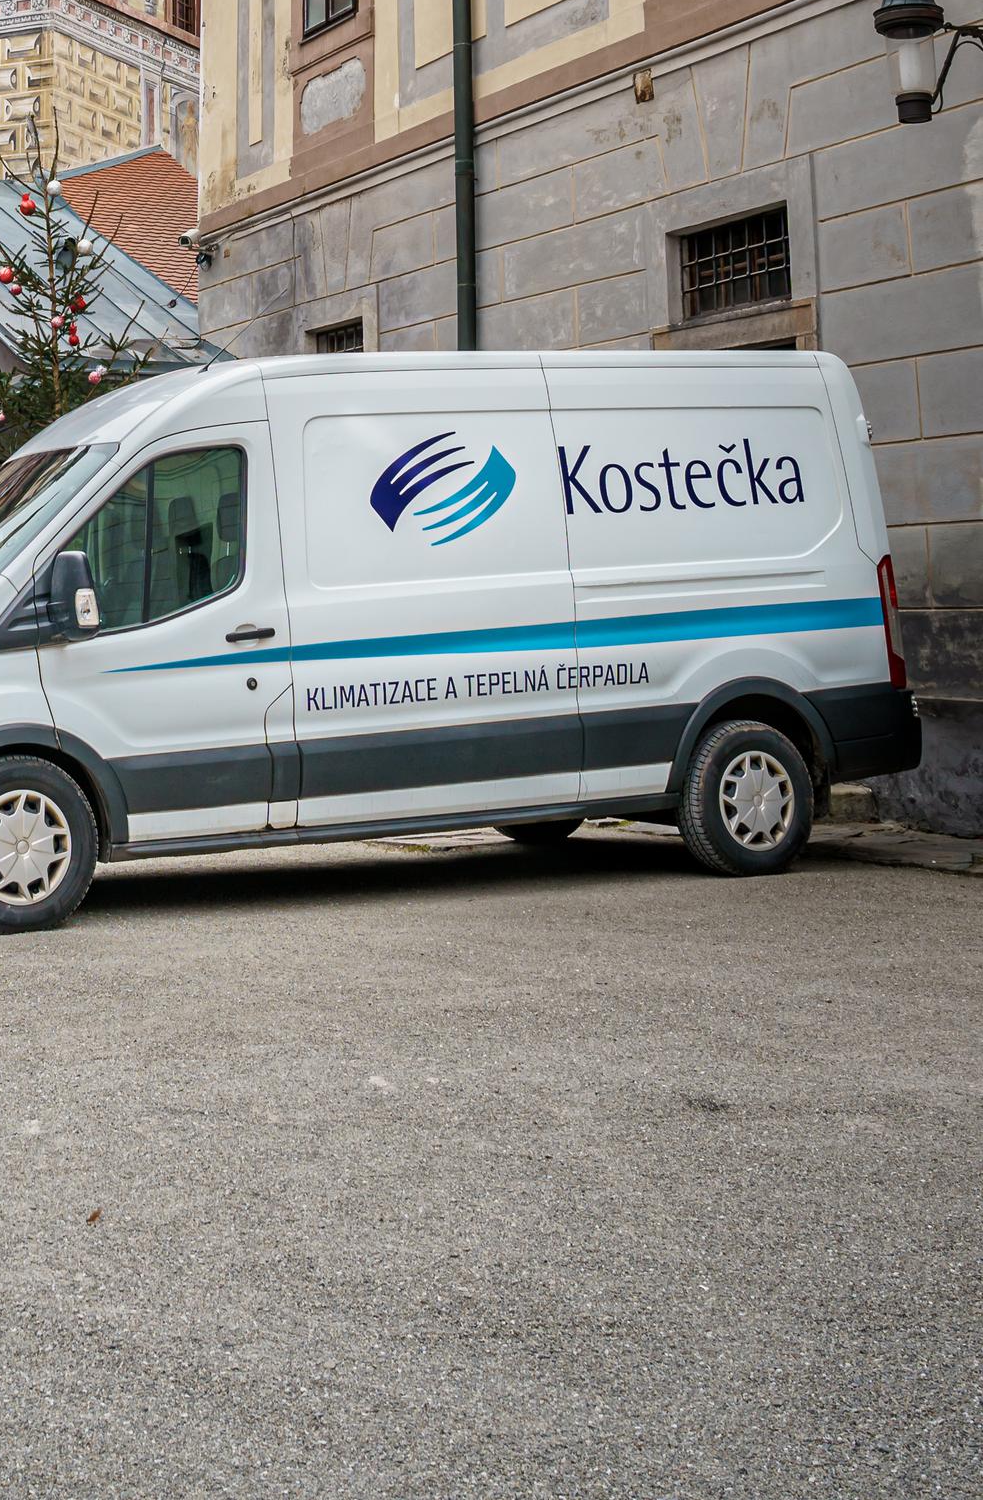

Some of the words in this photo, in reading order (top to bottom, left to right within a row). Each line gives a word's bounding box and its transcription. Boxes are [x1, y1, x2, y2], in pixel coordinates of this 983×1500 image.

[557, 438, 805, 515] Kostečka
[306, 677, 438, 711] KLIMATIZACE
[444, 676, 458, 699] A
[463, 665, 549, 697] TEPELNÁ
[556, 662, 650, 690] ČERPADLA
